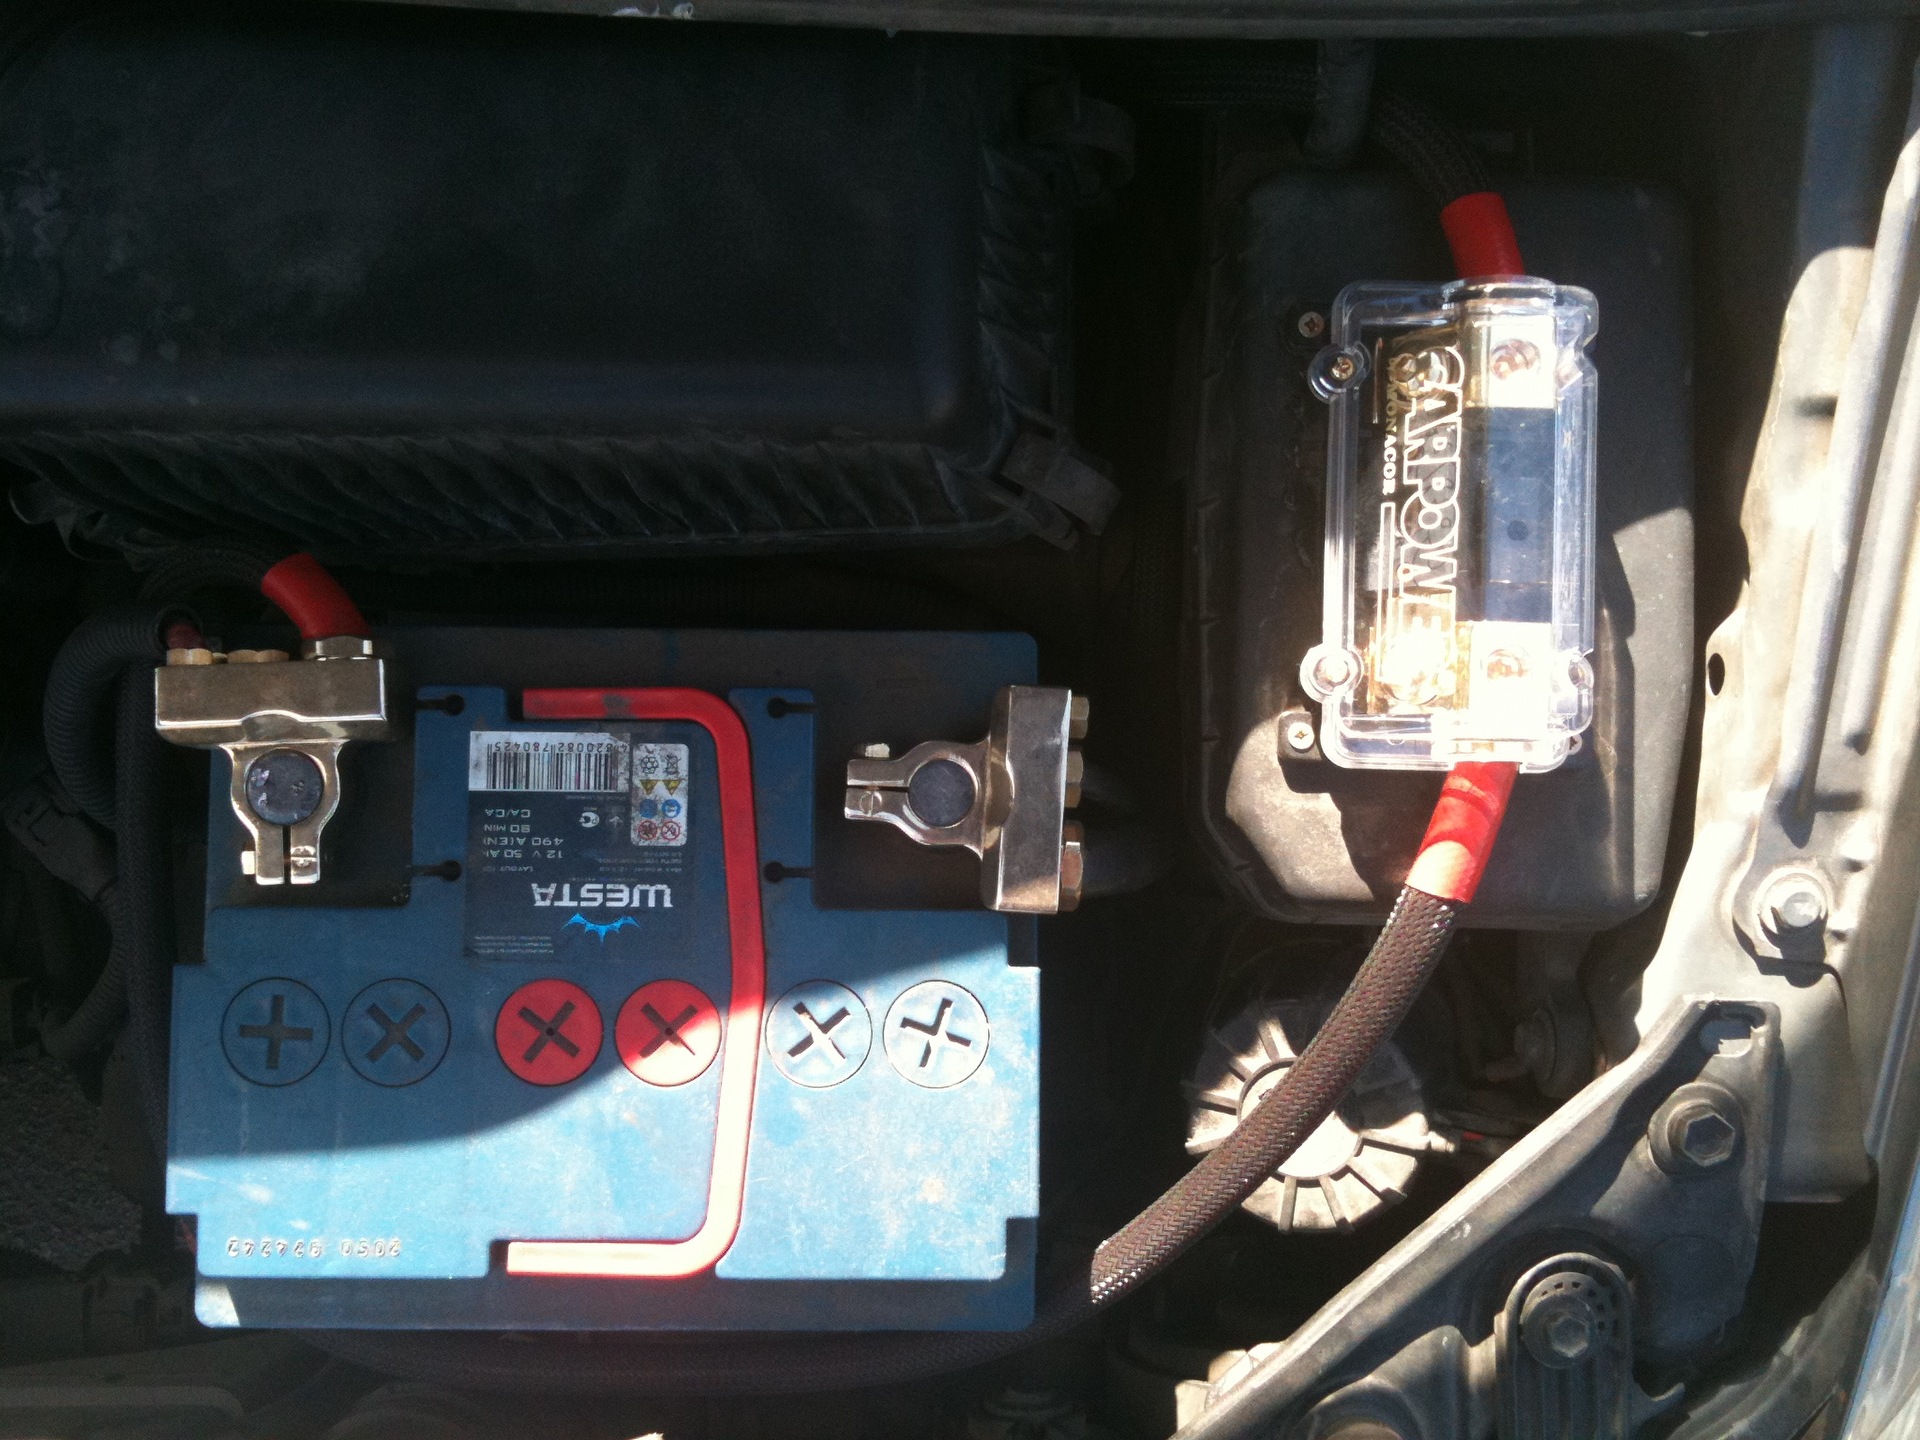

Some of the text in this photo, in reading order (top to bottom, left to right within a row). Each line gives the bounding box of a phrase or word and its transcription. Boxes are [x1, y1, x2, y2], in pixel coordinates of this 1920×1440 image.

[1382, 383, 1398, 496] MONACOR
[1400, 347, 1466, 682] CARPOWE
[494, 741, 549, 753] 780425
[484, 825, 506, 833] MIN
[531, 837, 564, 846] 490
[505, 849, 523, 858] 50
[546, 849, 563, 858] 12
[531, 883, 673, 908] WESTA
[340, 1237, 402, 1258] 2050
